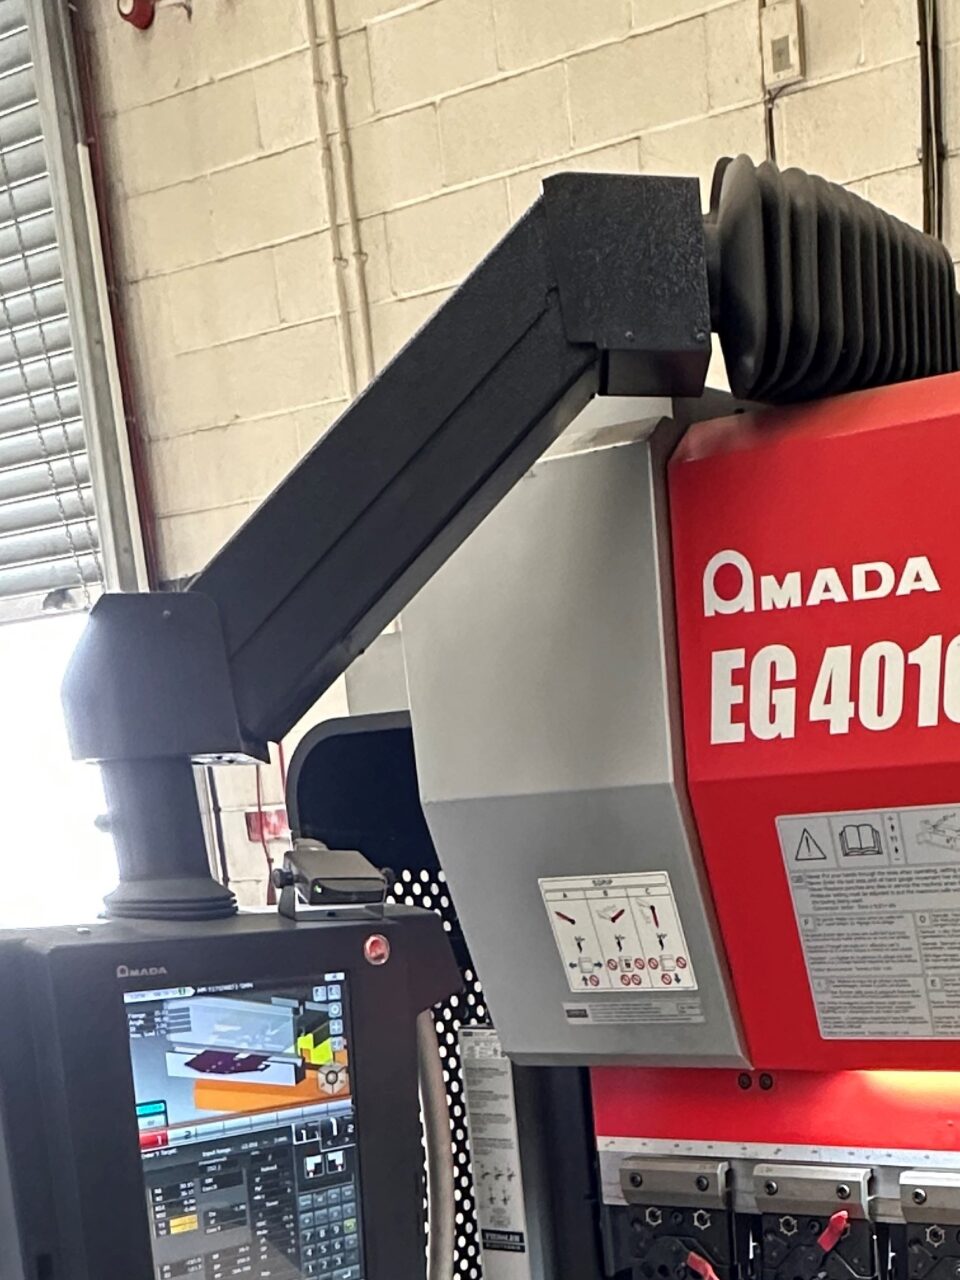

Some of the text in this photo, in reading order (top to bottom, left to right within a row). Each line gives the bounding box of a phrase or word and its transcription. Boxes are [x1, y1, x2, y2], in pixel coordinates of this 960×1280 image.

[703, 549, 941, 617] AMADA
[710, 644, 796, 744] EG
[116, 965, 168, 978] AMADA
